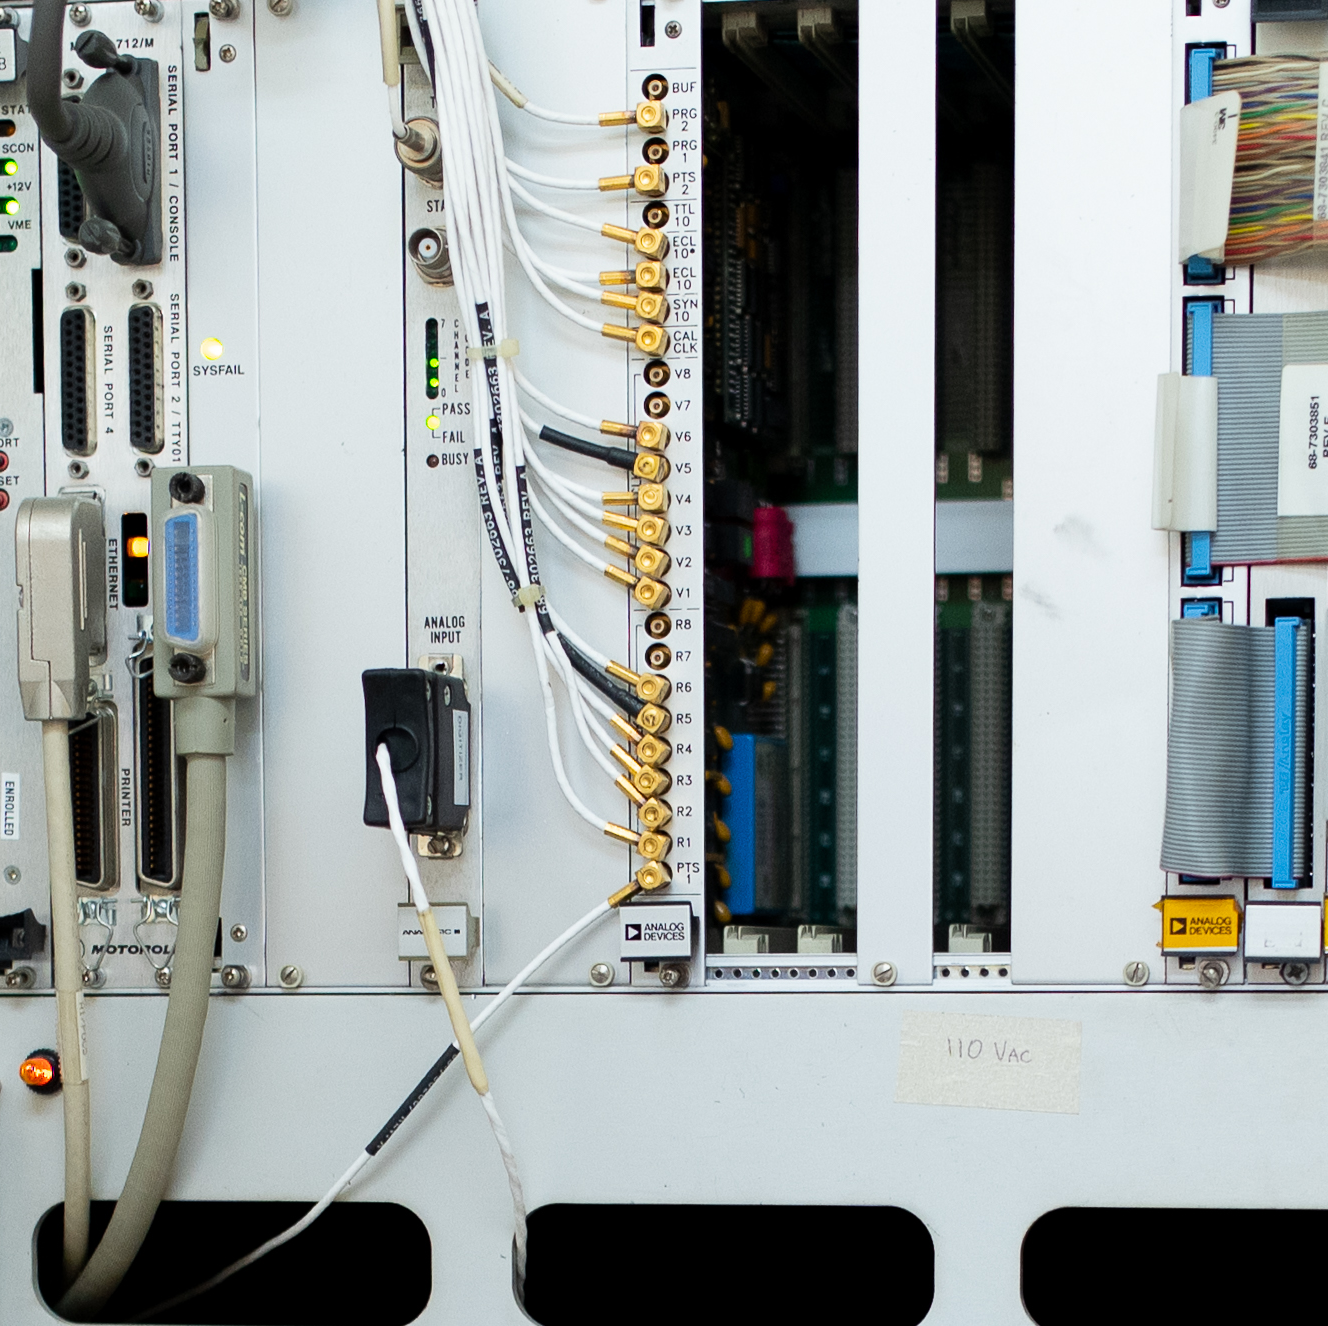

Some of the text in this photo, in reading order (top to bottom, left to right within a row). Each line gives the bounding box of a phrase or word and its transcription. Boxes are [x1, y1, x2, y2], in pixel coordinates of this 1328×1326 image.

[672, 82, 696, 93] BUF
[672, 109, 697, 119] PRG
[681, 121, 688, 131] 2
[2, 143, 34, 154] SCON
[672, 141, 697, 152] PRG
[168, 65, 179, 262] SERIAL PORT CONSOLE
[672, 172, 696, 183] PTS
[681, 185, 689, 195] 2
[674, 204, 695, 214] TTL
[8, 220, 31, 230] VME
[675, 216, 690, 227] 10
[673, 236, 696, 247] ECL
[673, 267, 696, 278] ECL
[677, 279, 691, 290] 10
[673, 299, 698, 310] SYN
[675, 311, 689, 322] 10
[170, 294, 181, 388] SERIAL PORT
[673, 331, 698, 342] CAL
[673, 343, 697, 354] CLK
[104, 326, 113, 419] SERIAL PORT
[193, 365, 244, 376] SYSFAIL
[675, 368, 691, 379] V8
[442, 403, 470, 415] PASS
[675, 400, 691, 411] V7
[443, 431, 465, 443] FAIL
[675, 431, 691, 442] V6
[1308, 395, 1319, 469] 68-7303851
[442, 453, 469, 465] BUSY
[675, 463, 691, 473] V5
[675, 494, 691, 505] V4
[676, 525, 692, 536] V3
[676, 557, 692, 568] V2
[109, 538, 118, 611] ETHERNET
[676, 588, 691, 599] V1
[424, 616, 465, 629] ANALOG
[676, 619, 692, 630] R8
[430, 631, 461, 643] INPUT
[676, 651, 691, 661] R7
[676, 682, 692, 692] R6
[676, 713, 692, 724] R5
[677, 744, 692, 755] R4
[677, 775, 692, 786] R3
[122, 768, 131, 827] PRINTER
[4, 781, 14, 836] ENROLLED
[677, 806, 692, 816] R2
[677, 837, 691, 847] R1
[677, 863, 700, 873] PTS
[644, 922, 684, 932] ANALOG
[1190, 917, 1232, 927] ANALOG
[644, 931, 685, 941] DEVICES
[1189, 926, 1232, 935] DEVICES
[948, 1038, 983, 1059] 110
